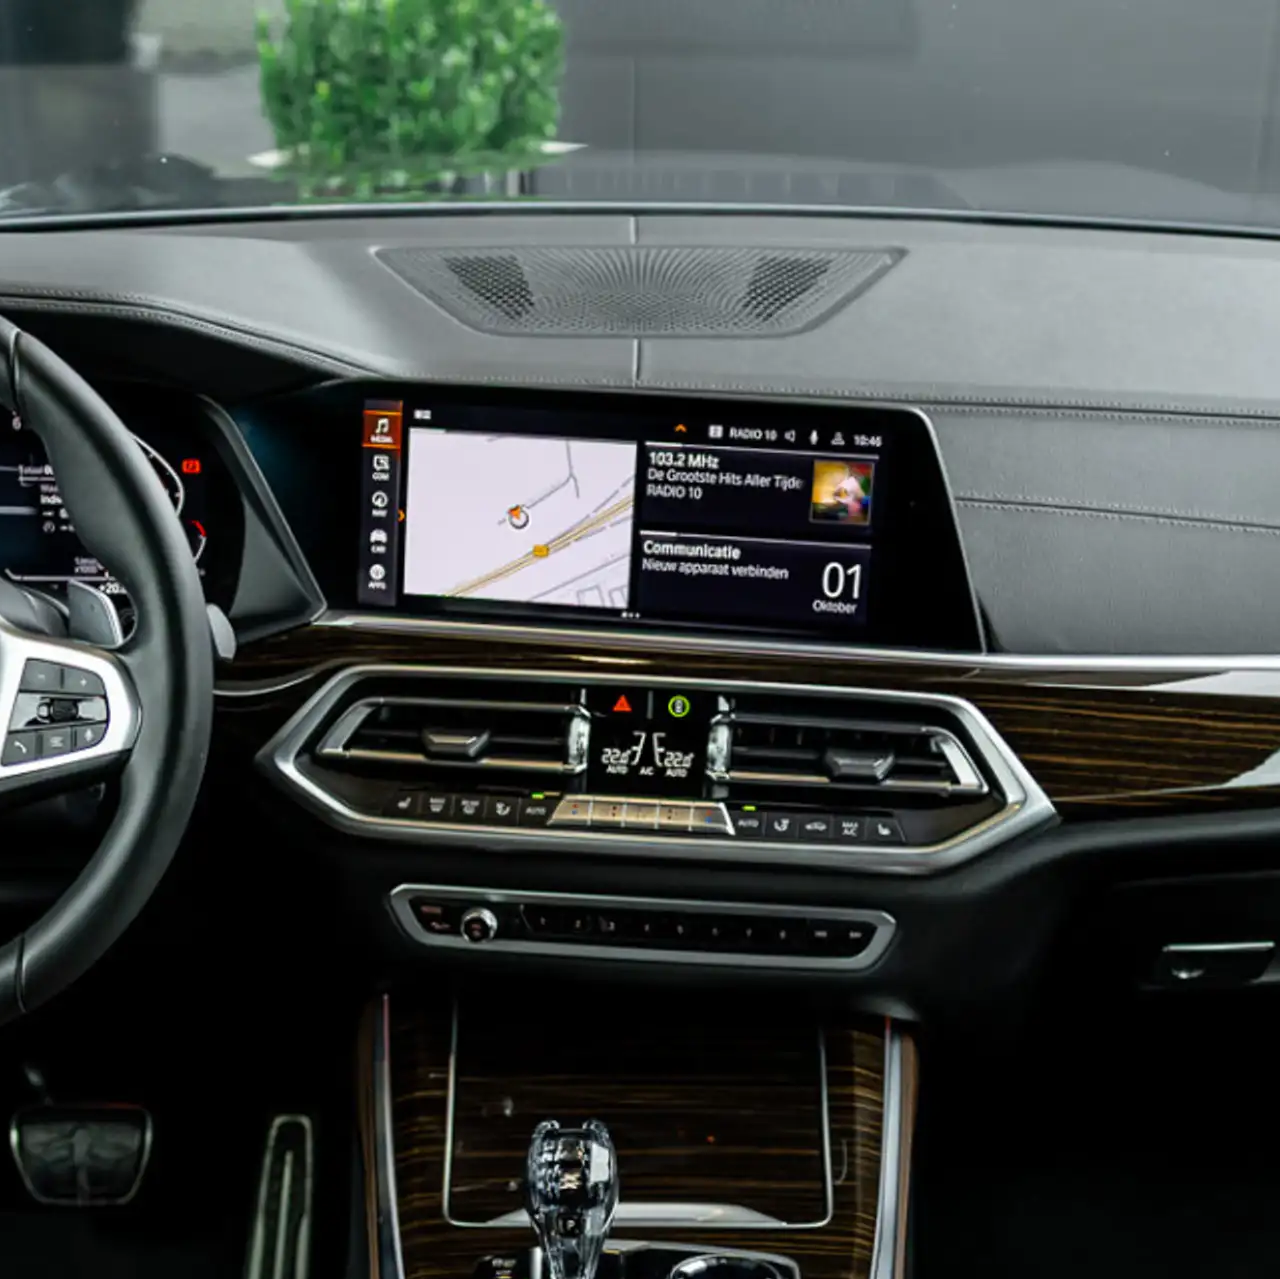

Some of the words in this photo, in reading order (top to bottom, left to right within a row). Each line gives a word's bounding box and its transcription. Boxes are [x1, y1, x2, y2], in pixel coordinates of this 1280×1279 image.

[729, 427, 763, 441] RADIO
[765, 429, 778, 442] 10
[649, 451, 686, 467] 103.2
[687, 453, 720, 469] MHz
[647, 468, 665, 481] De
[666, 469, 717, 485] Grootste
[719, 472, 742, 486] Hits
[744, 473, 772, 487] Aller
[646, 484, 686, 498] RADIO
[688, 486, 703, 500] 10
[643, 540, 742, 560] Communicatie
[642, 558, 677, 572] Nieuw
[678, 562, 730, 577] apparaat
[731, 564, 789, 580] verbinden
[822, 561, 862, 600] 01
[812, 600, 858, 615] Oktober
